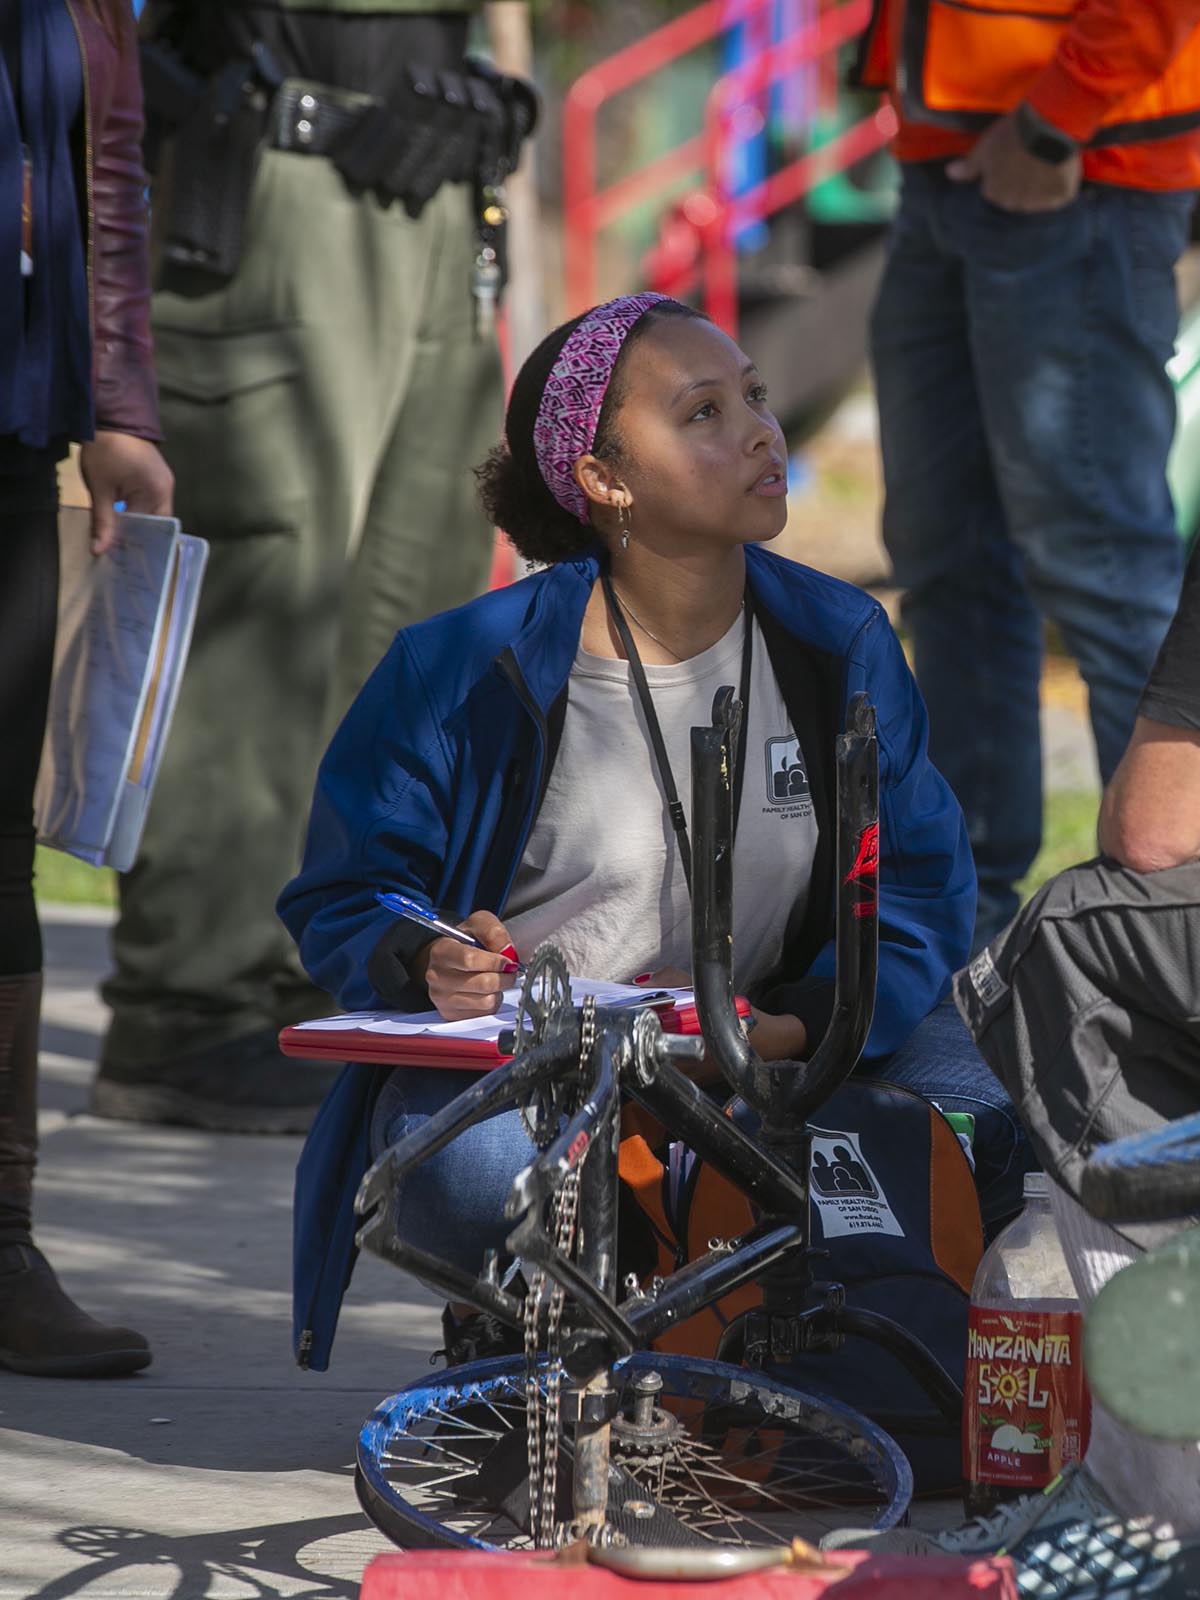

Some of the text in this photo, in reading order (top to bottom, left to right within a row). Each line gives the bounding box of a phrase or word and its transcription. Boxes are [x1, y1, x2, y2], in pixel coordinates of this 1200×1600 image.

[968, 1328, 1072, 1365] MANZANITA
[978, 1363, 1050, 1411] SOL
[986, 1452, 1022, 1468] APPLE
